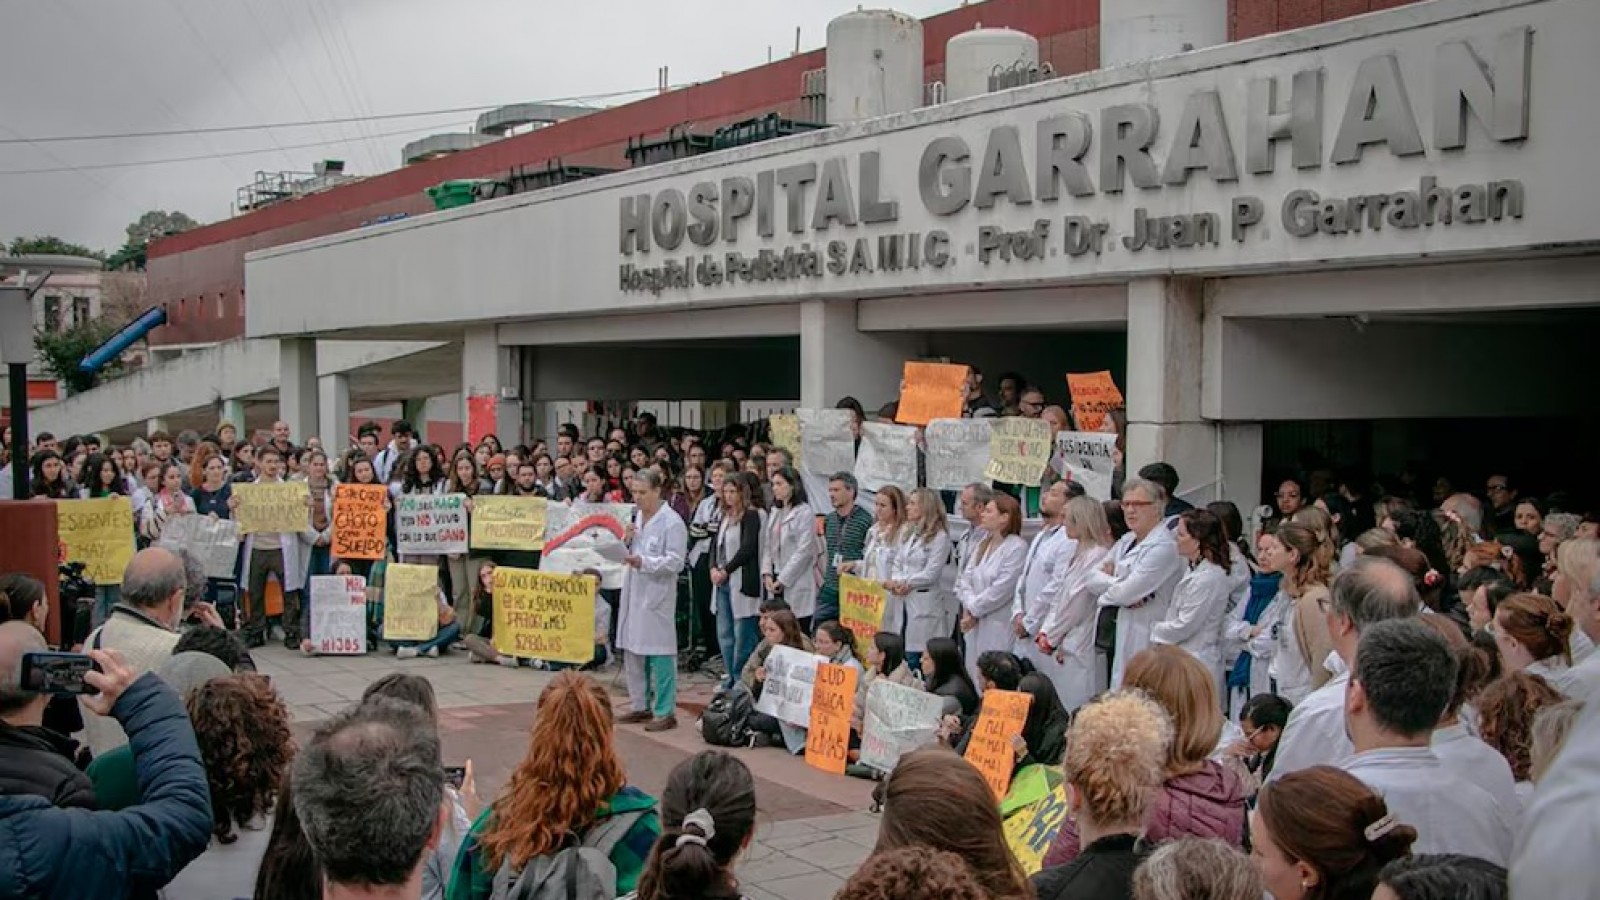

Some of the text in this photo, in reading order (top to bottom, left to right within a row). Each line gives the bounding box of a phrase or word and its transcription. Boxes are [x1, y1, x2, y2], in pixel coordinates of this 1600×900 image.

[619, 26, 1533, 256] HOSPITAL GARRAHAN
[619, 255, 695, 296] Hospital
[697, 255, 723, 286] de
[978, 219, 1056, 265] Prof.
[1064, 215, 1115, 257] Dr.
[1123, 208, 1221, 252] Juan
[1231, 196, 1270, 242] P.
[1282, 176, 1524, 237] Garrahan
[1059, 439, 1111, 459] RESIDENCIA
[57, 510, 131, 531] ESIDENTES
[335, 512, 378, 529] CHOTO
[416, 514, 431, 527] NO
[433, 513, 460, 525] VIVO
[438, 529, 465, 543] GANO
[336, 539, 385, 555] SUELDO
[535, 594, 573, 614] SEMANA
[549, 613, 566, 630] MES
[322, 637, 360, 651] HIJOS
